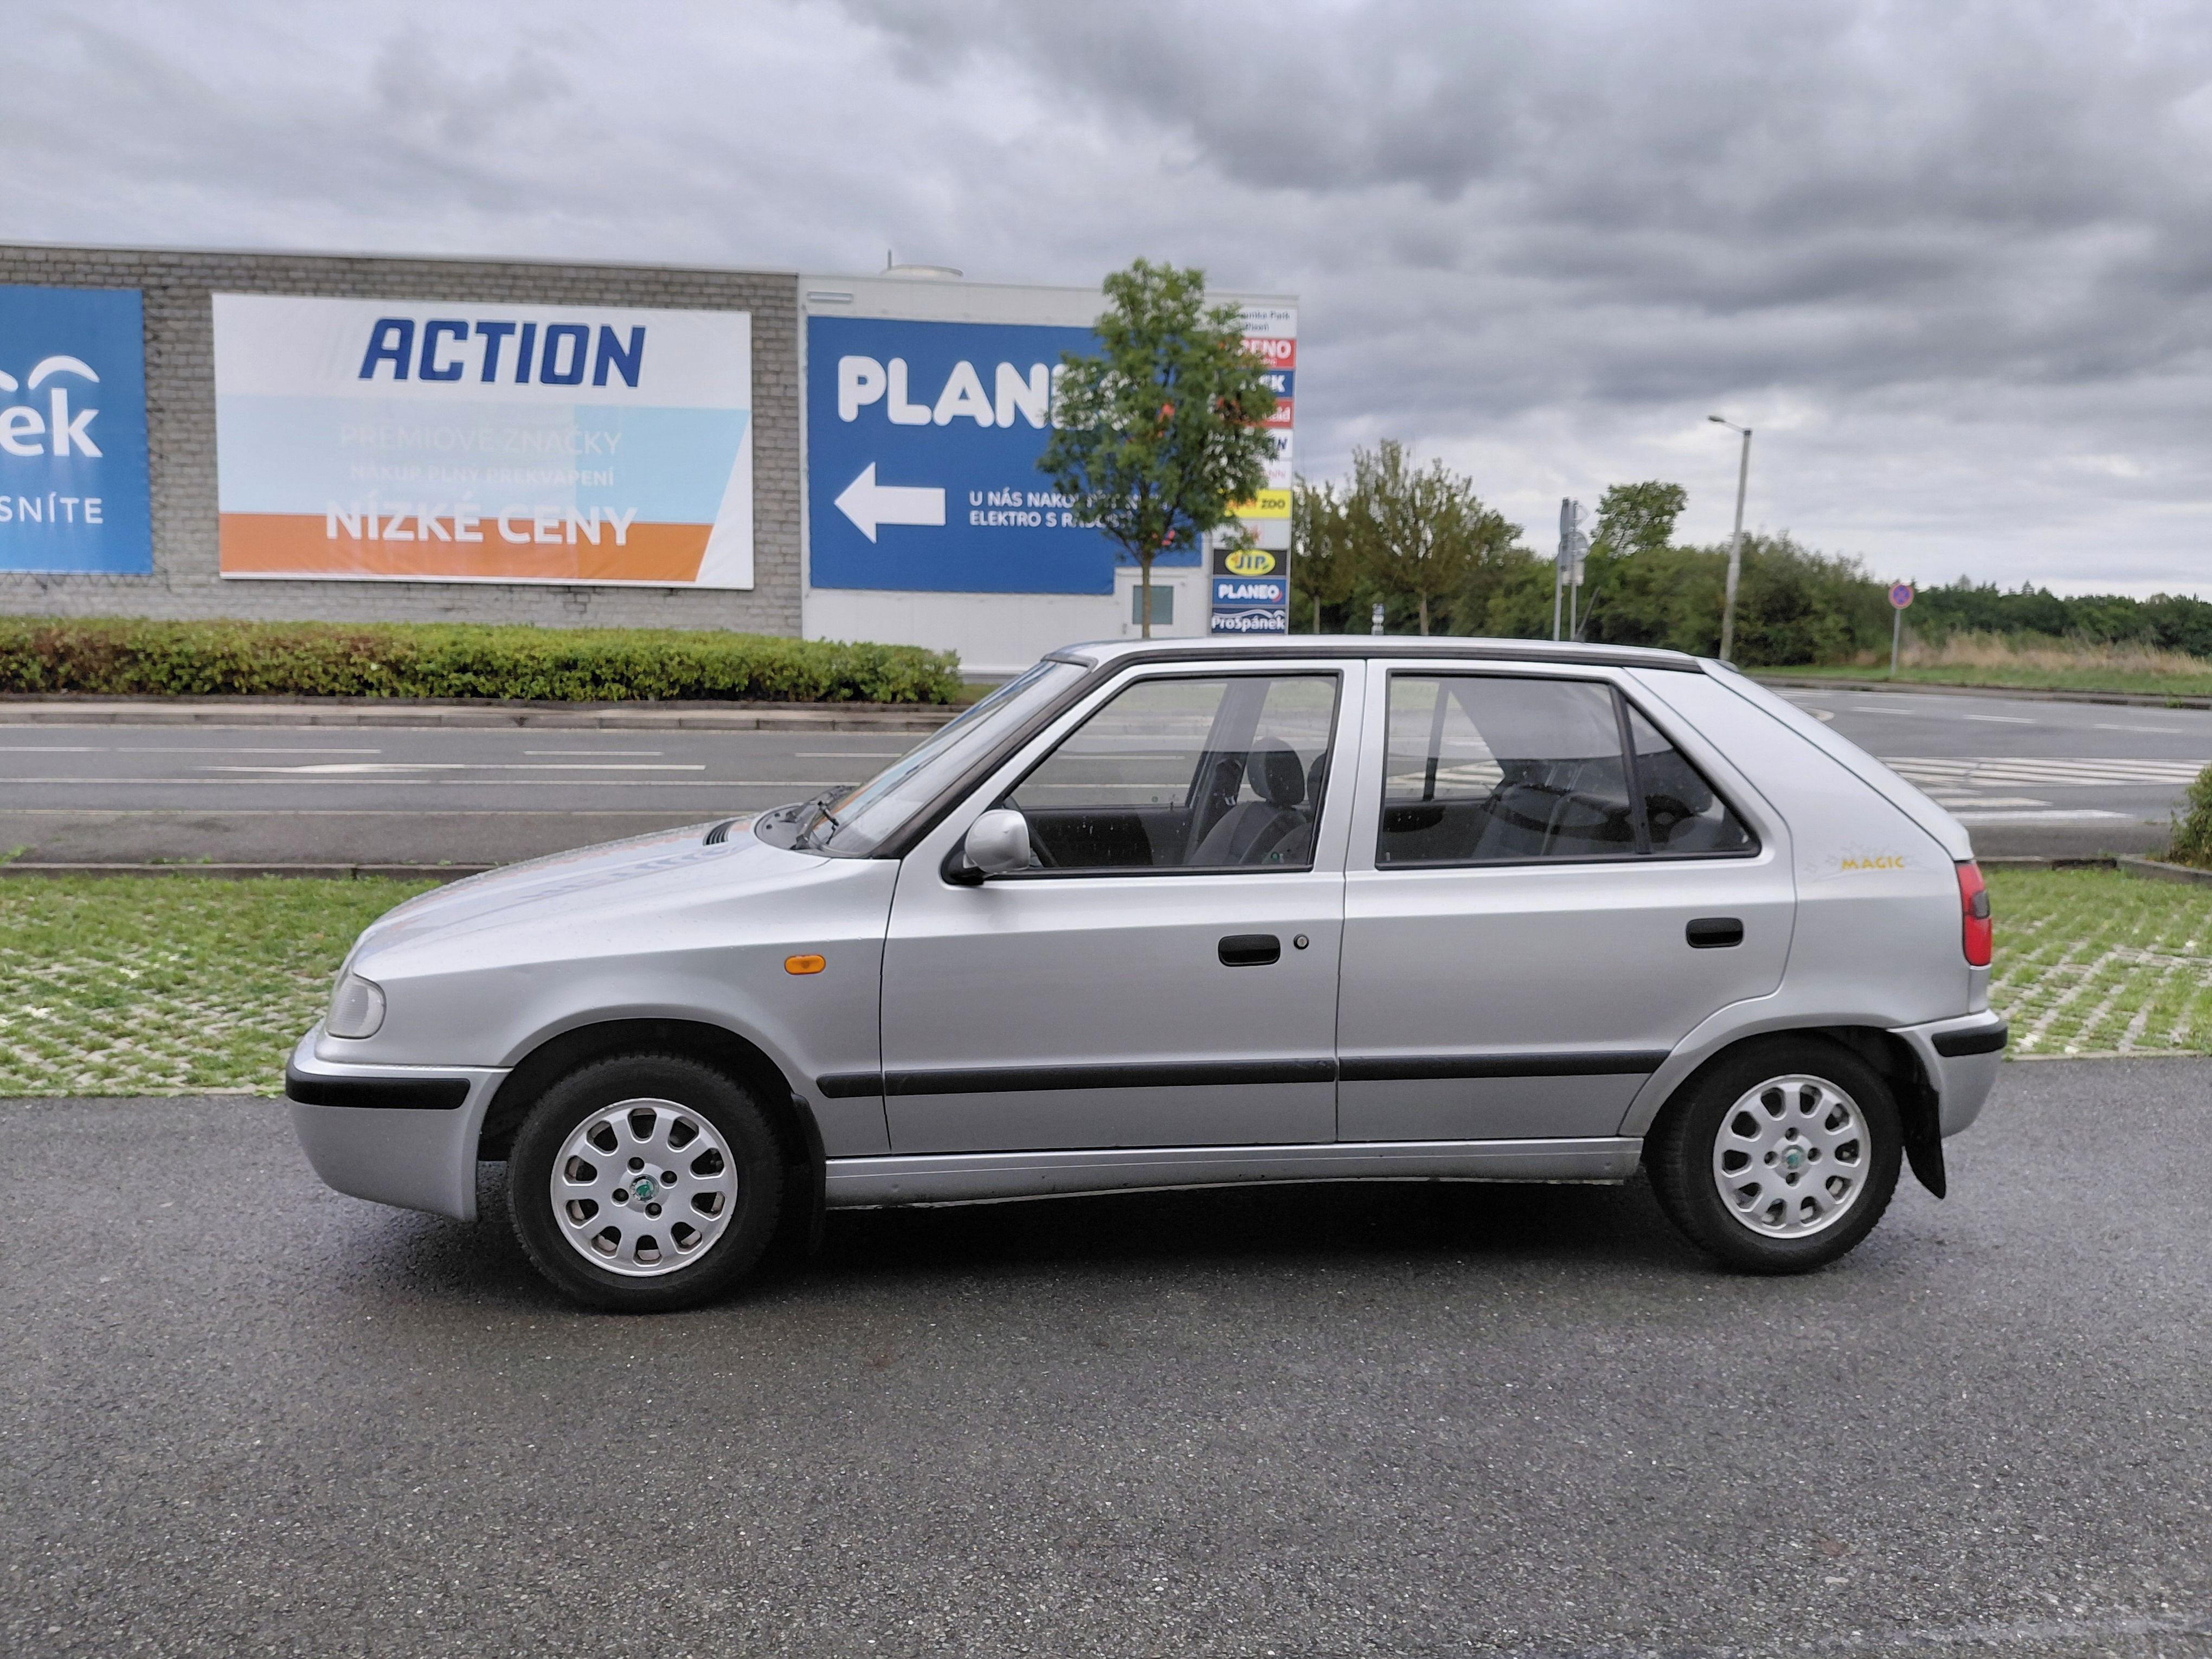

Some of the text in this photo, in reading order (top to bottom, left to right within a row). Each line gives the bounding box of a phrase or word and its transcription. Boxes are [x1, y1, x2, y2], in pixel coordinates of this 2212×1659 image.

[357, 317, 645, 388] ACTION
[503, 425, 621, 455] ZNAČKY
[969, 490, 983, 506] U
[987, 486, 1023, 507] NÁS
[1261, 499, 1285, 509] ZOO
[326, 489, 638, 546] NÍZKÉ CENY
[969, 510, 1041, 528] ELEKTRO
[1045, 512, 1057, 528] S
[1235, 555, 1266, 569] JIP
[1218, 584, 1279, 599] PLANEO
[1842, 856, 1904, 870] MAGIC
